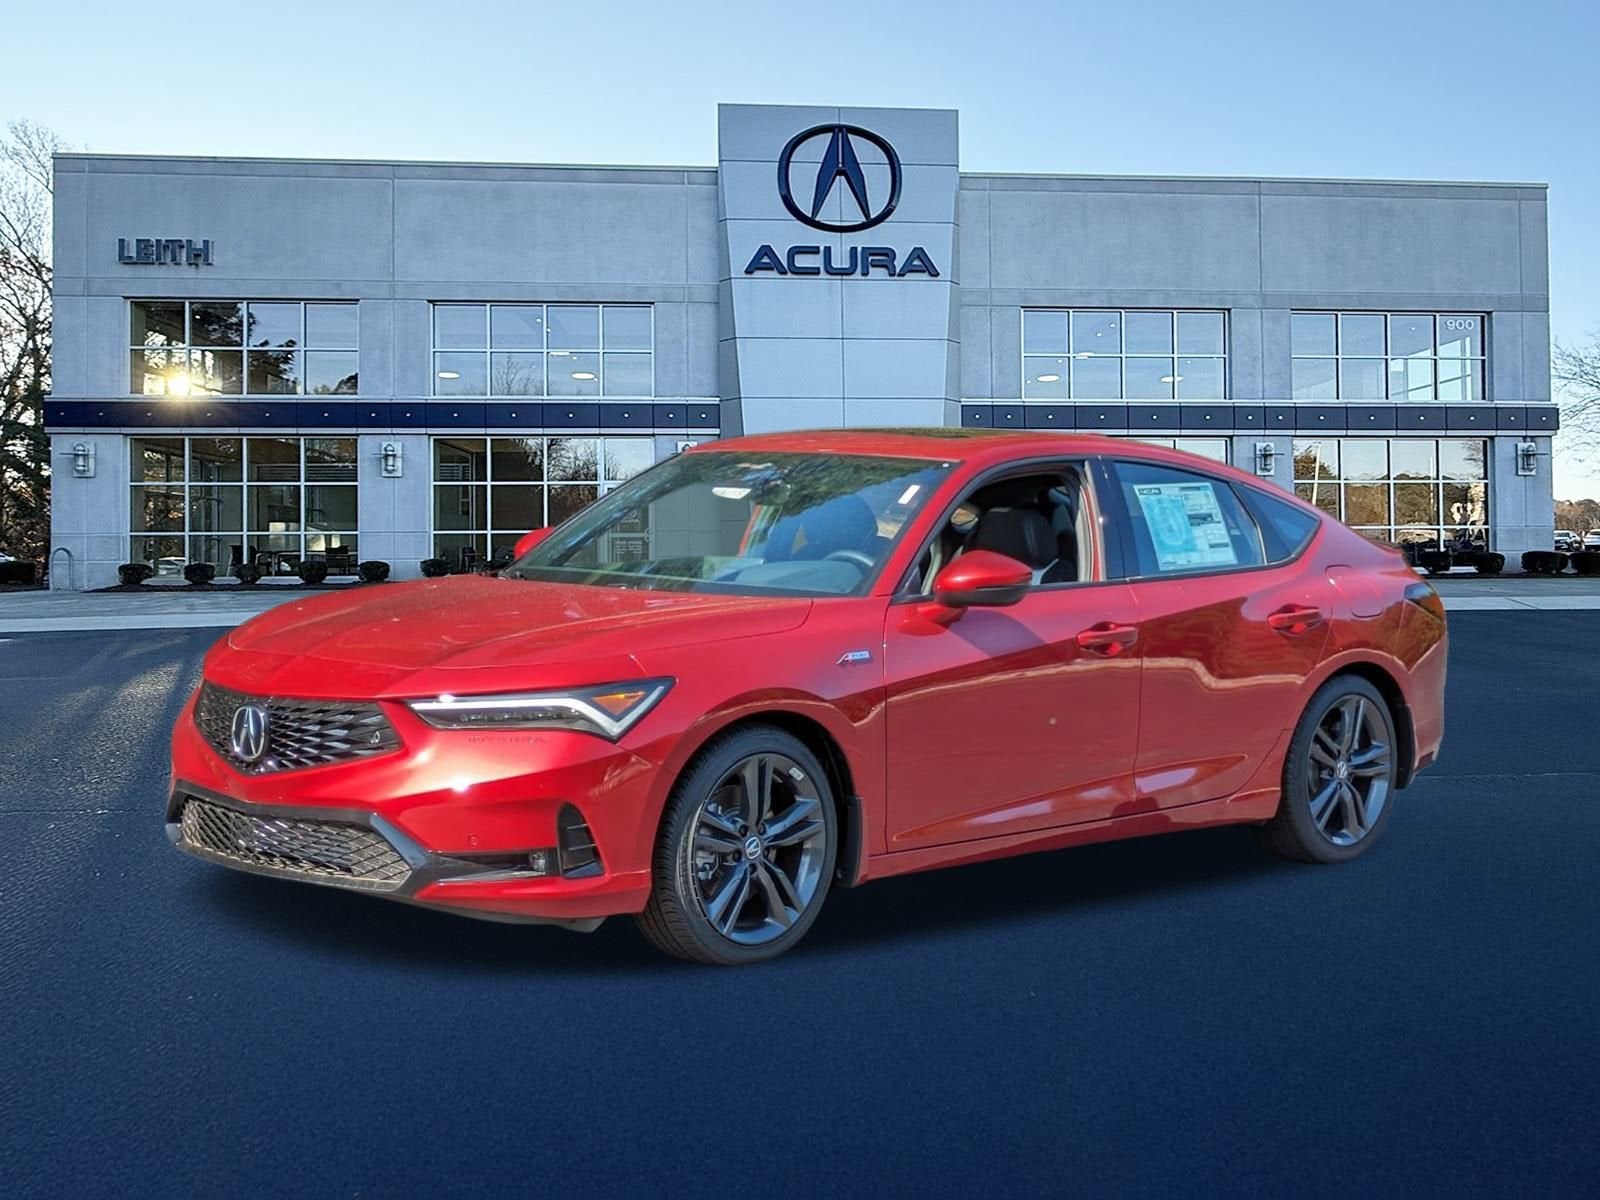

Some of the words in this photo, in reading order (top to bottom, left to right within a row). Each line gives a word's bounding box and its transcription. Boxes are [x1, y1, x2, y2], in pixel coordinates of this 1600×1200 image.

[118, 238, 211, 264] LEITH
[744, 244, 941, 277] ACURA
[1446, 319, 1475, 330] 900
